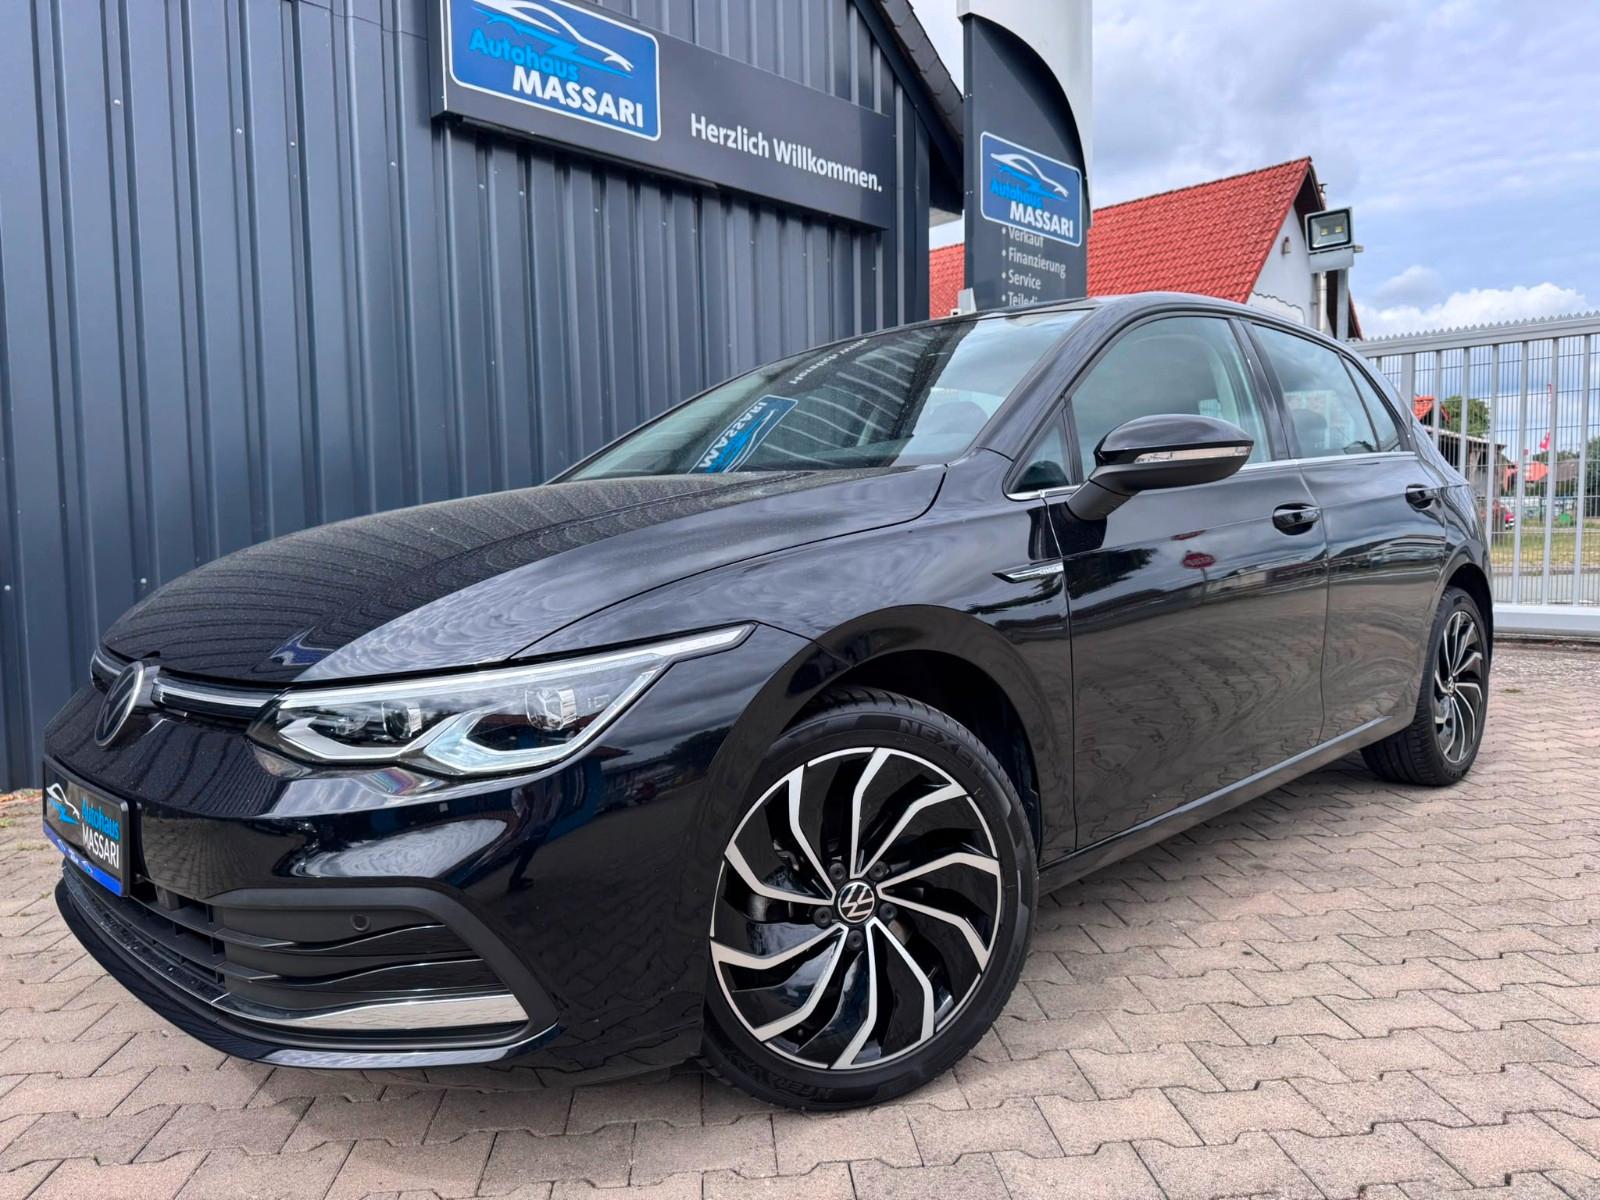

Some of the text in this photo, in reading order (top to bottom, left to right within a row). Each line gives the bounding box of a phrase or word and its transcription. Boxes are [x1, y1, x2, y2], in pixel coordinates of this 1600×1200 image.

[469, 29, 579, 82] Autohaus
[512, 65, 644, 128] MASSARI
[690, 113, 882, 192] Herzlich Willkommen.
[1009, 201, 1074, 238] MASSARI
[1008, 247, 1066, 279] Finanzierung
[1008, 269, 1042, 290] Service
[81, 797, 120, 841] Autohaus
[81, 823, 120, 870] MASSARI
